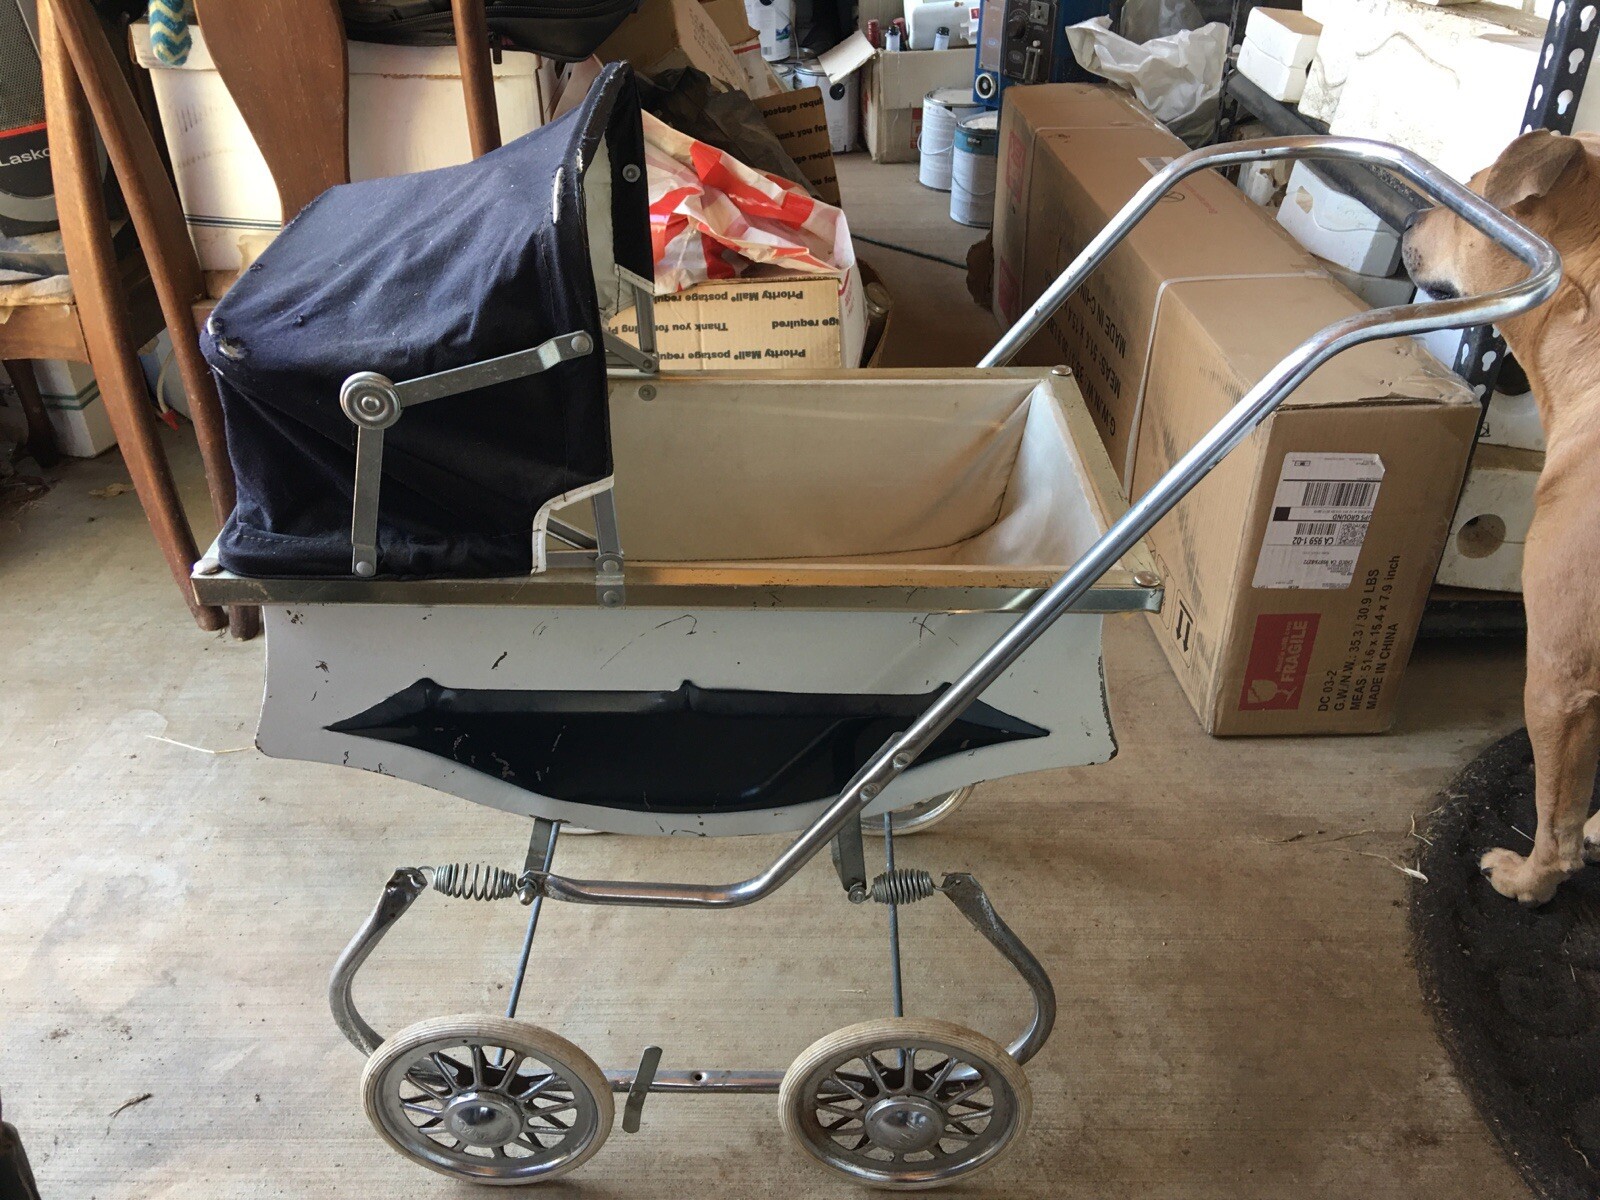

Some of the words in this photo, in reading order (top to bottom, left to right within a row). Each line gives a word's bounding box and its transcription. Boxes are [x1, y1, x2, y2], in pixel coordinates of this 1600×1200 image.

[763, 104, 797, 118] postage
[775, 129, 795, 140] hank
[797, 128, 812, 138] you
[685, 292, 728, 302] postage
[762, 290, 804, 300] Priority
[1096, 306, 1105, 325] IN
[622, 324, 638, 334] ing
[673, 323, 691, 331] you
[695, 323, 728, 332] Thank
[771, 318, 819, 329] required
[1104, 316, 1127, 359] MADE
[687, 350, 731, 360] postage
[764, 349, 806, 358] Priority
[1310, 537, 1323, 545] 959
[1325, 537, 1334, 545] CA
[1384, 555, 1401, 580] inch
[1363, 569, 1379, 593] LBS
[1378, 584, 1393, 601] 7.9
[1357, 598, 1372, 620] 30.9
[1370, 614, 1385, 637] 15.4
[1348, 630, 1364, 652] 35.3
[1379, 623, 1399, 659] CHINA
[1281, 621, 1308, 682] FRAGILE
[1362, 649, 1376, 671] 51.6
[1374, 662, 1387, 673] IN
[1323, 670, 1337, 693] 03-2
[1350, 674, 1367, 710] MEAS:
[1366, 677, 1383, 709] MADE
[1318, 697, 1330, 711] DC
